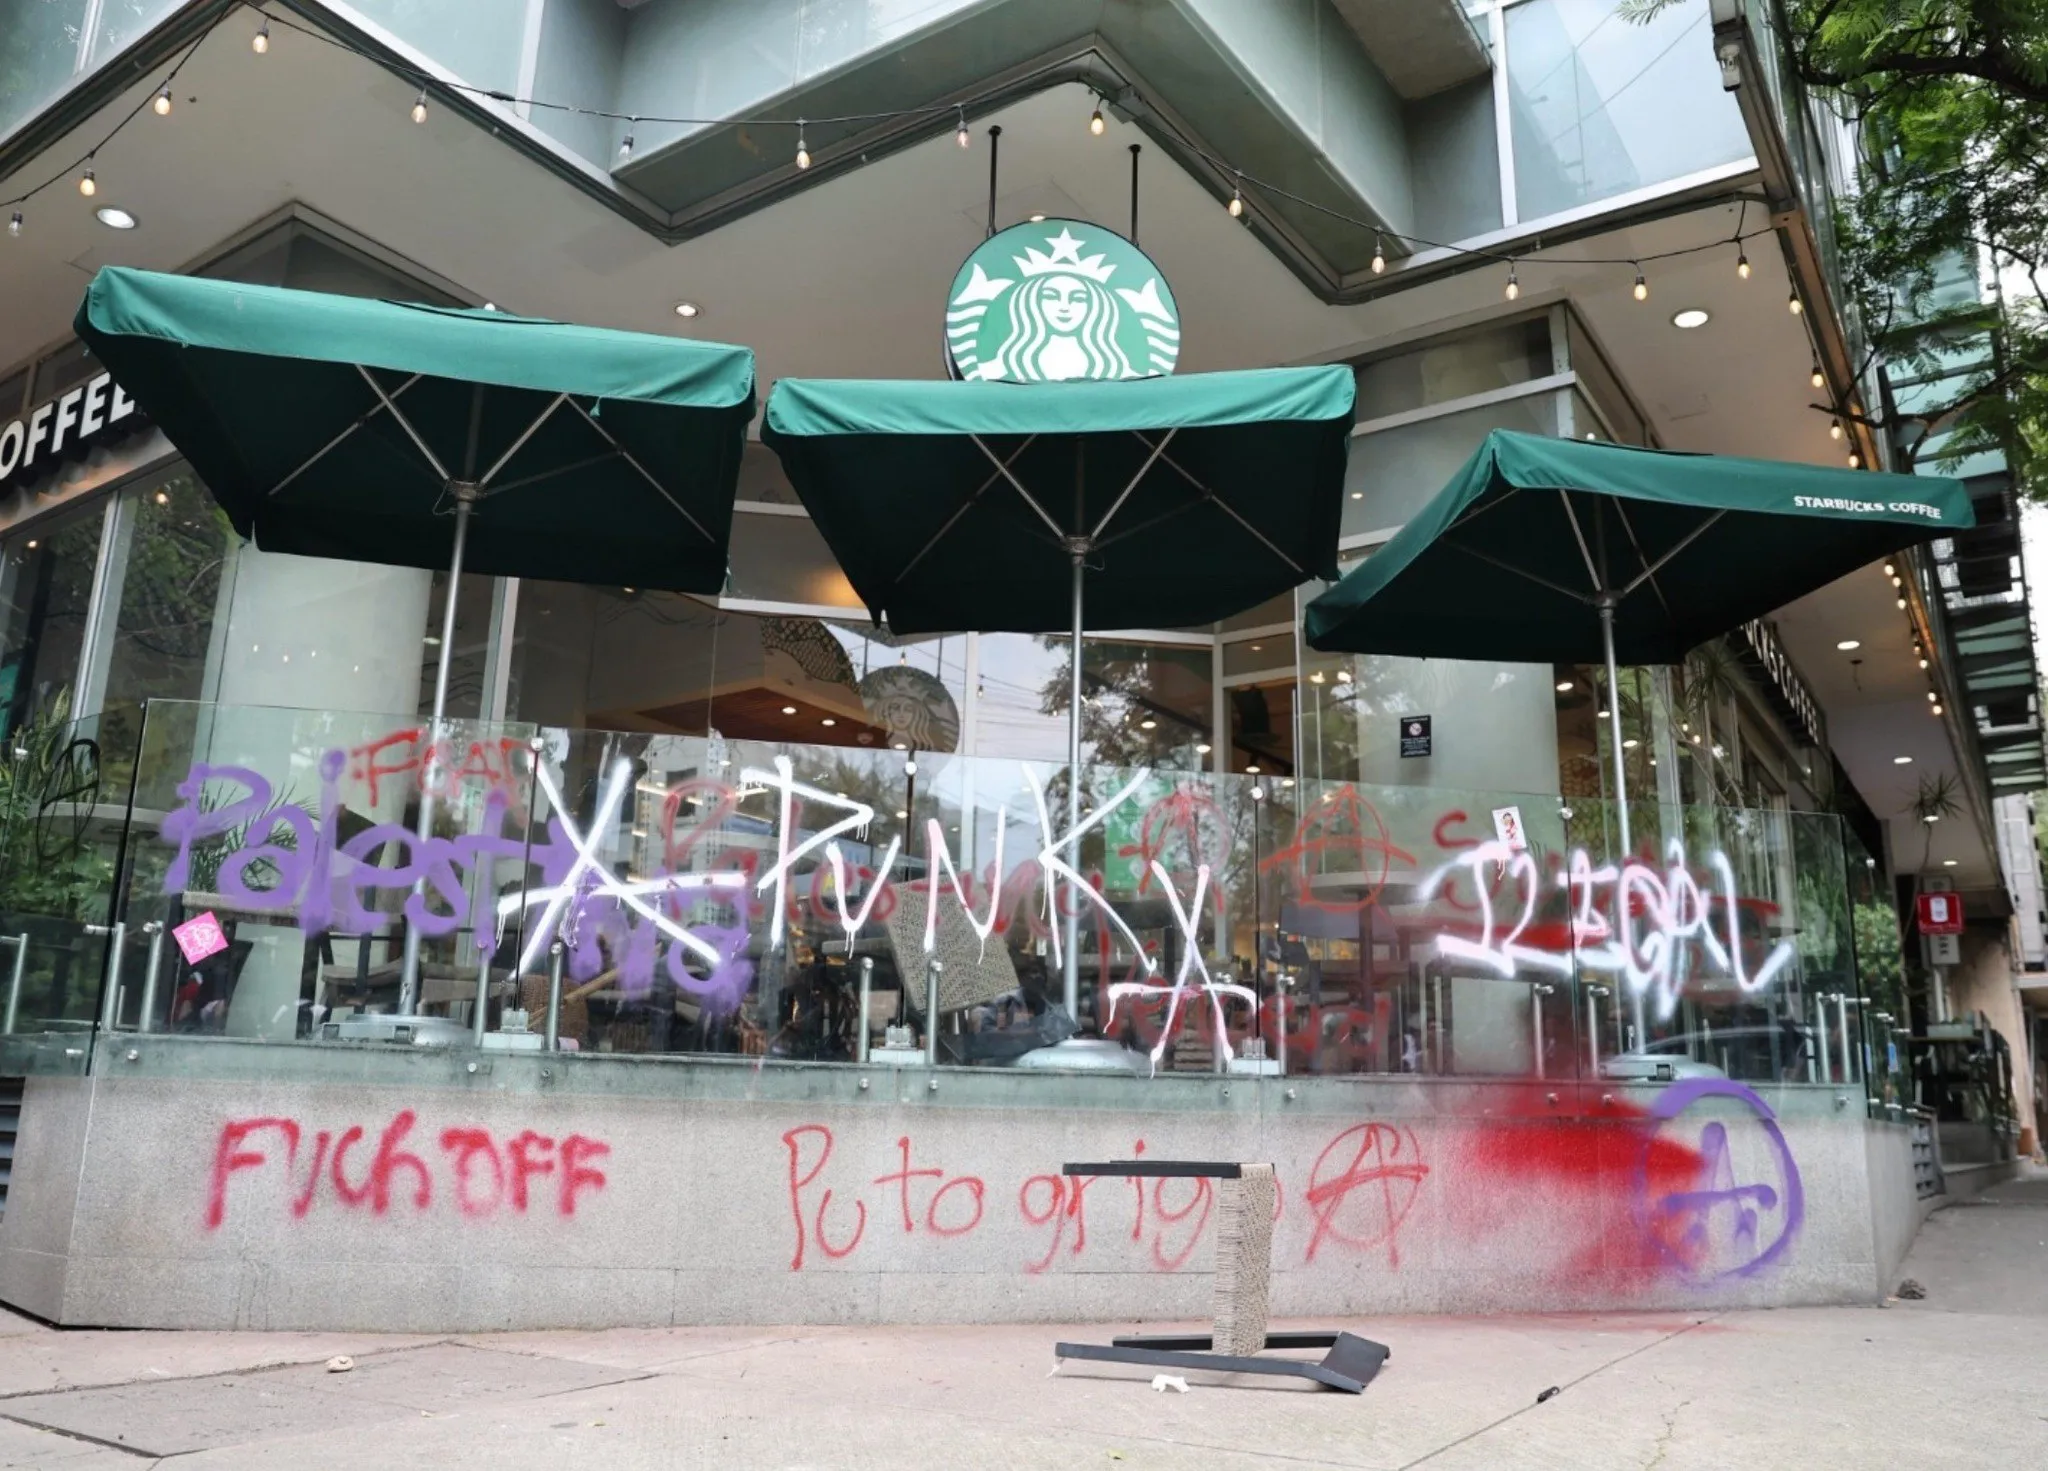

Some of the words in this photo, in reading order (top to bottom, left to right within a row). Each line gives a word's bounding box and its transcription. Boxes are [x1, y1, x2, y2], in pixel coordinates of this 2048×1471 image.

[1794, 495, 1885, 512] STARBUCKS
[1888, 502, 1942, 519] COFFEE
[440, 1127, 610, 1217] OFF
[783, 1124, 986, 1271] Puto
